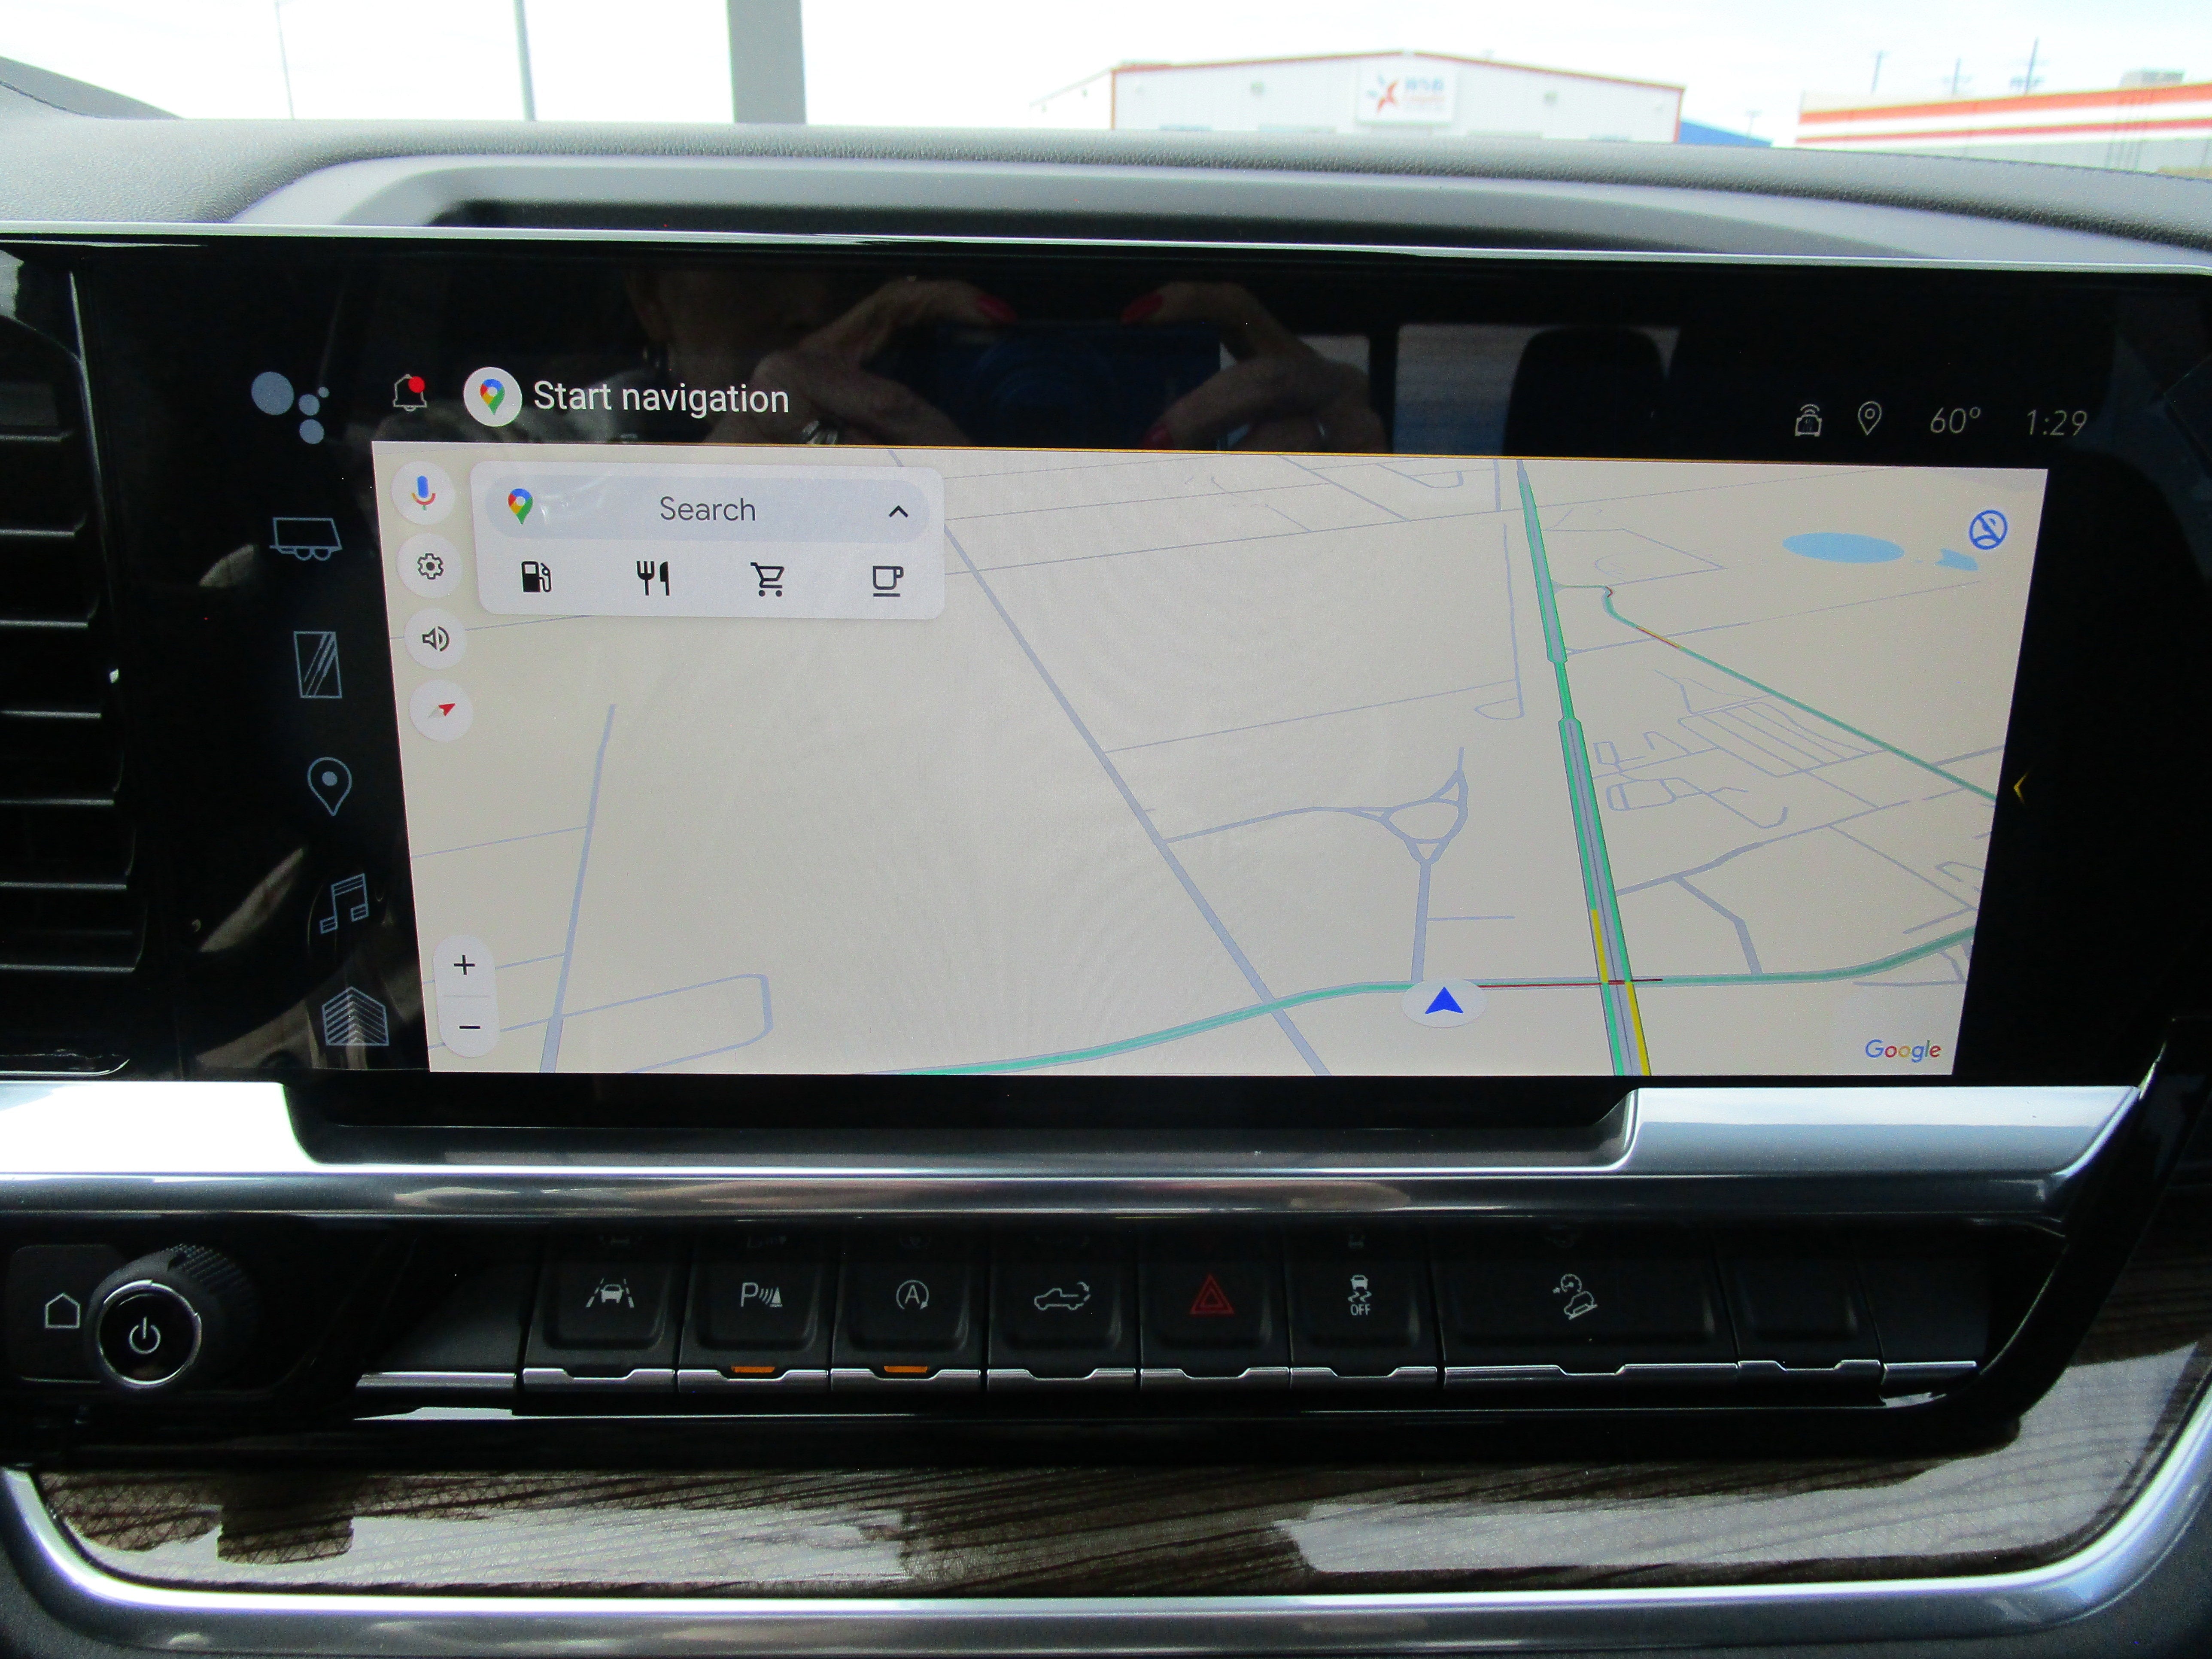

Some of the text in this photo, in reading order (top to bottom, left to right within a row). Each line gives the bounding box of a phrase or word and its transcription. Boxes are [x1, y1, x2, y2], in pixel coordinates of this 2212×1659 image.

[534, 380, 789, 419] Start navigation
[1929, 407, 1981, 434] 60°
[2027, 409, 2088, 437] 1:29
[660, 495, 756, 522] Search
[1865, 1039, 1942, 1063] Google
[740, 1282, 759, 1307] P
[905, 1284, 920, 1304] A
[1350, 1303, 1371, 1316] OFF
